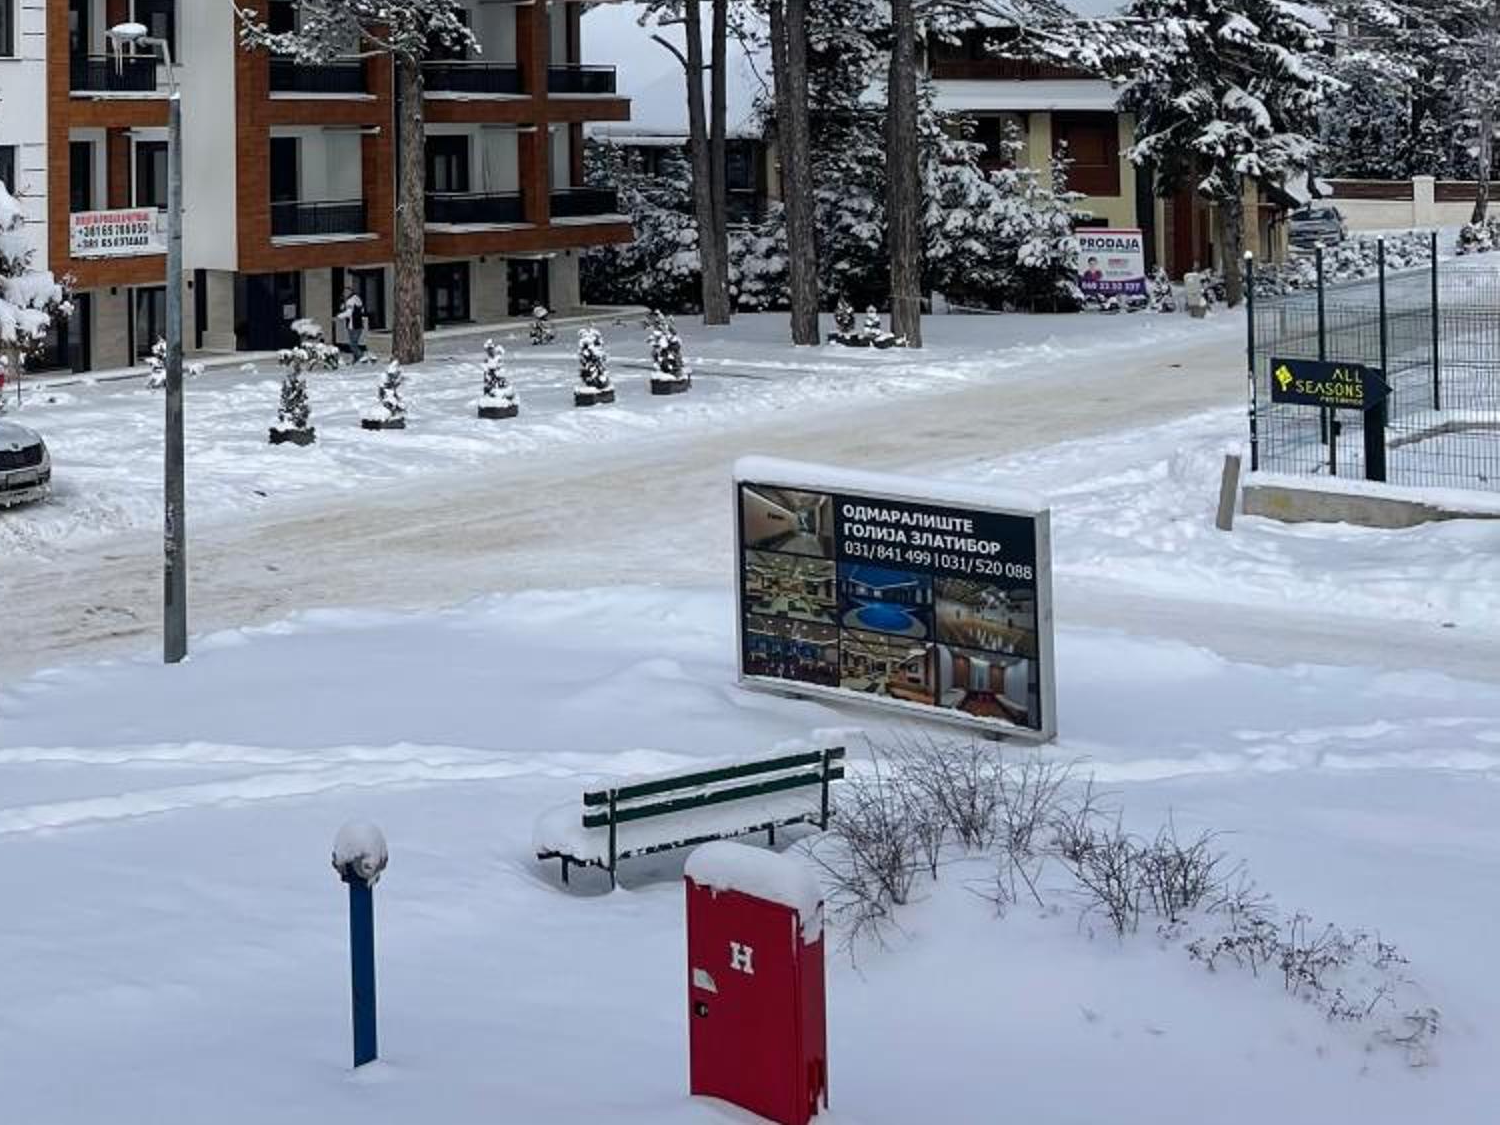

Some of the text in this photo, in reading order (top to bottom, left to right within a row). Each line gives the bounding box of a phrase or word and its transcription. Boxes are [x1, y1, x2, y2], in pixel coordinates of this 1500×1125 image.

[1079, 238, 1139, 249] PRODAJA
[1332, 368, 1363, 383] ALL
[1295, 380, 1364, 398] SEASONS
[843, 504, 973, 533] ОДМАРАЛИШТЕ
[843, 522, 1001, 555] ГОЛИЈА ЗЛАТИБОР
[845, 541, 902, 562] 031/841
[905, 550, 930, 566] 499
[729, 941, 755, 975] H
